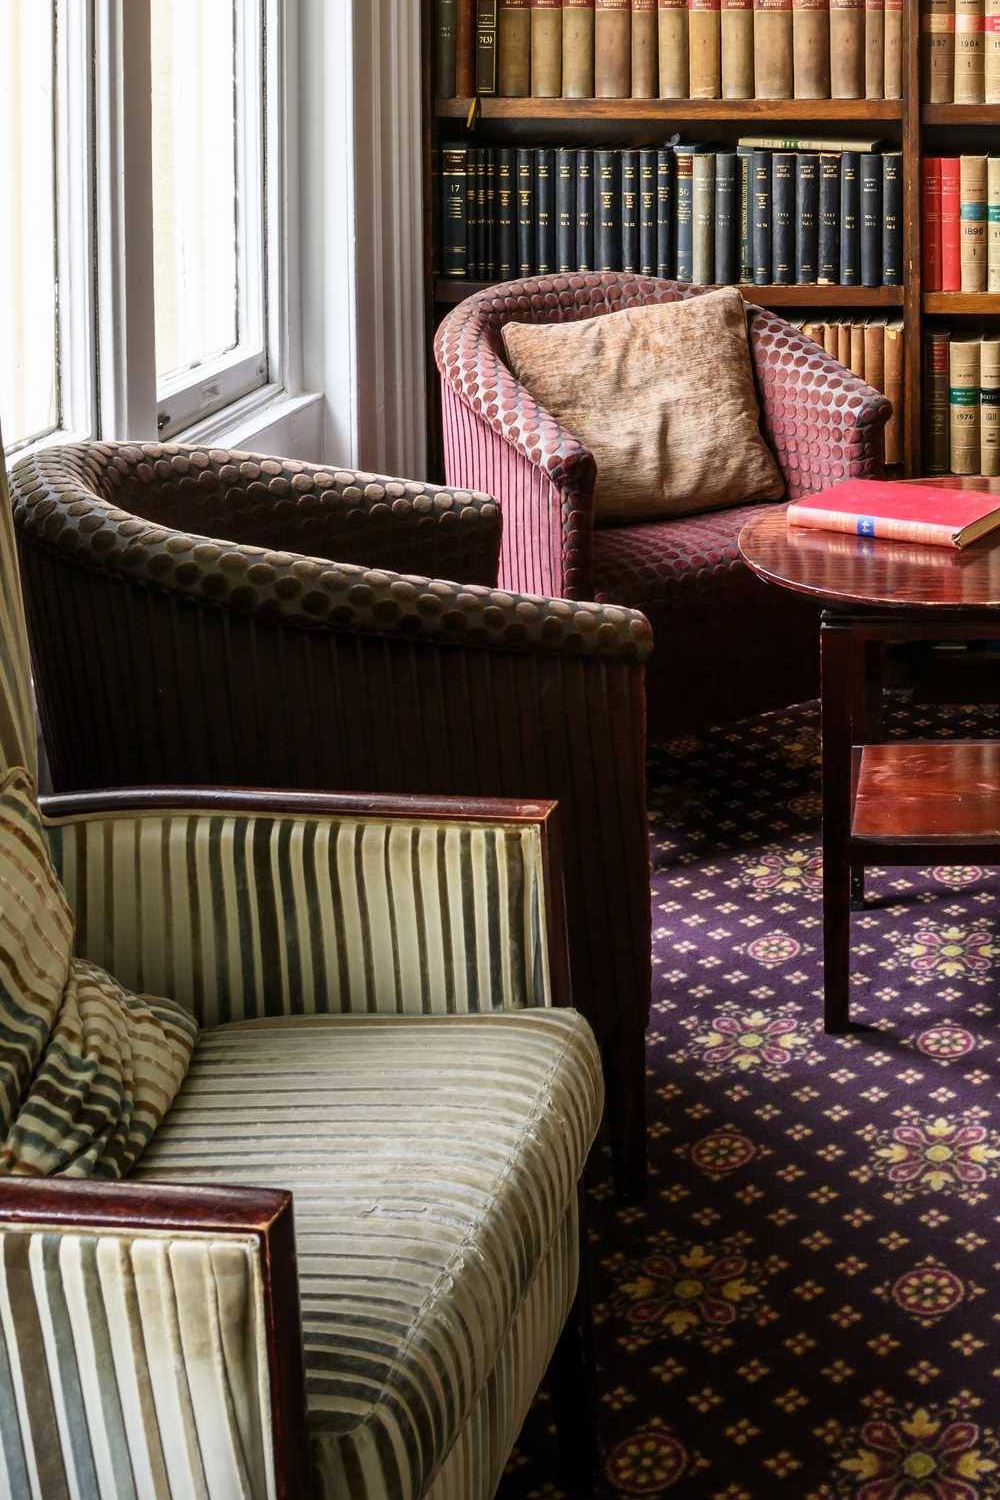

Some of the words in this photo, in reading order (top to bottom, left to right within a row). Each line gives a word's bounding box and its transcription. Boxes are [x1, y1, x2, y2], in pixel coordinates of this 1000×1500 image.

[480, 36, 493, 44] 7(3)
[960, 40, 980, 48] 1904
[451, 184, 460, 192] 17
[964, 227, 984, 235] 1896
[956, 413, 974, 421] 1976
